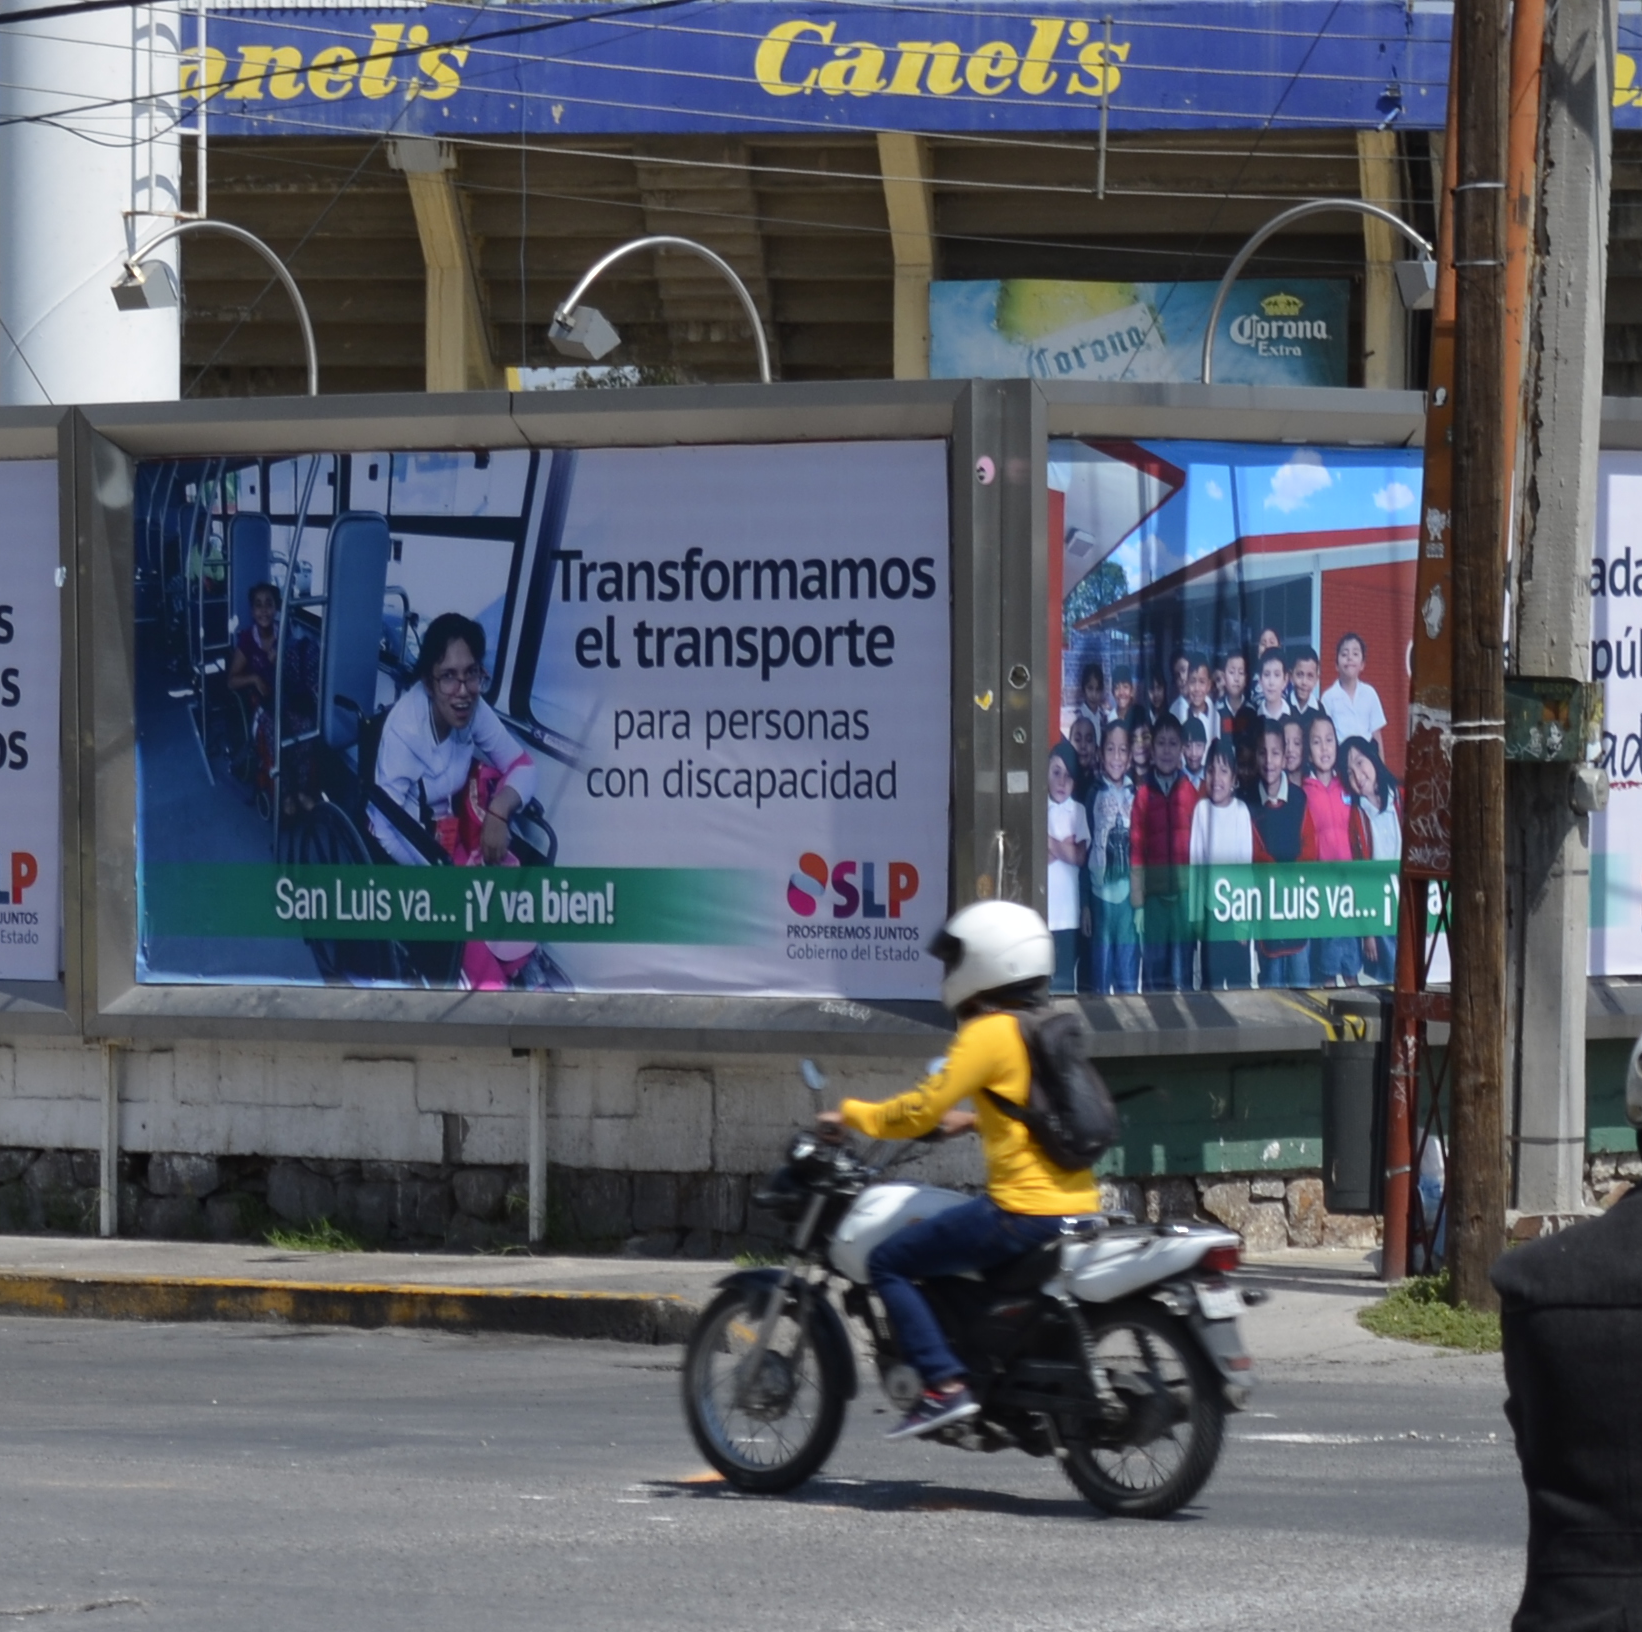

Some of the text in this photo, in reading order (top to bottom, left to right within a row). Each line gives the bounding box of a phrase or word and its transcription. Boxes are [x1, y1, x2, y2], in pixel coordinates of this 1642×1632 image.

[179, 22, 471, 101] anel's
[756, 17, 1131, 98] Canel's
[1229, 313, 1329, 346] Corona
[1257, 341, 1302, 358] Extra
[551, 546, 936, 602] Transformamos
[575, 614, 895, 682] el transporte
[614, 707, 691, 751] para
[705, 706, 870, 751] personas
[586, 758, 898, 810] con discapacidad
[274, 877, 615, 932] San Luis va... ¡Y va bien!
[831, 860, 919, 919] SLP
[1213, 877, 1263, 922] San
[1269, 876, 1320, 920] Luis
[1325, 884, 1377, 918] va...
[0, 911, 39, 925] JUNTOS
[0, 929, 39, 945] Estado
[786, 925, 920, 941] PROSPEREMOS JUNTOS
[786, 944, 920, 962] Gobierno del Estado
